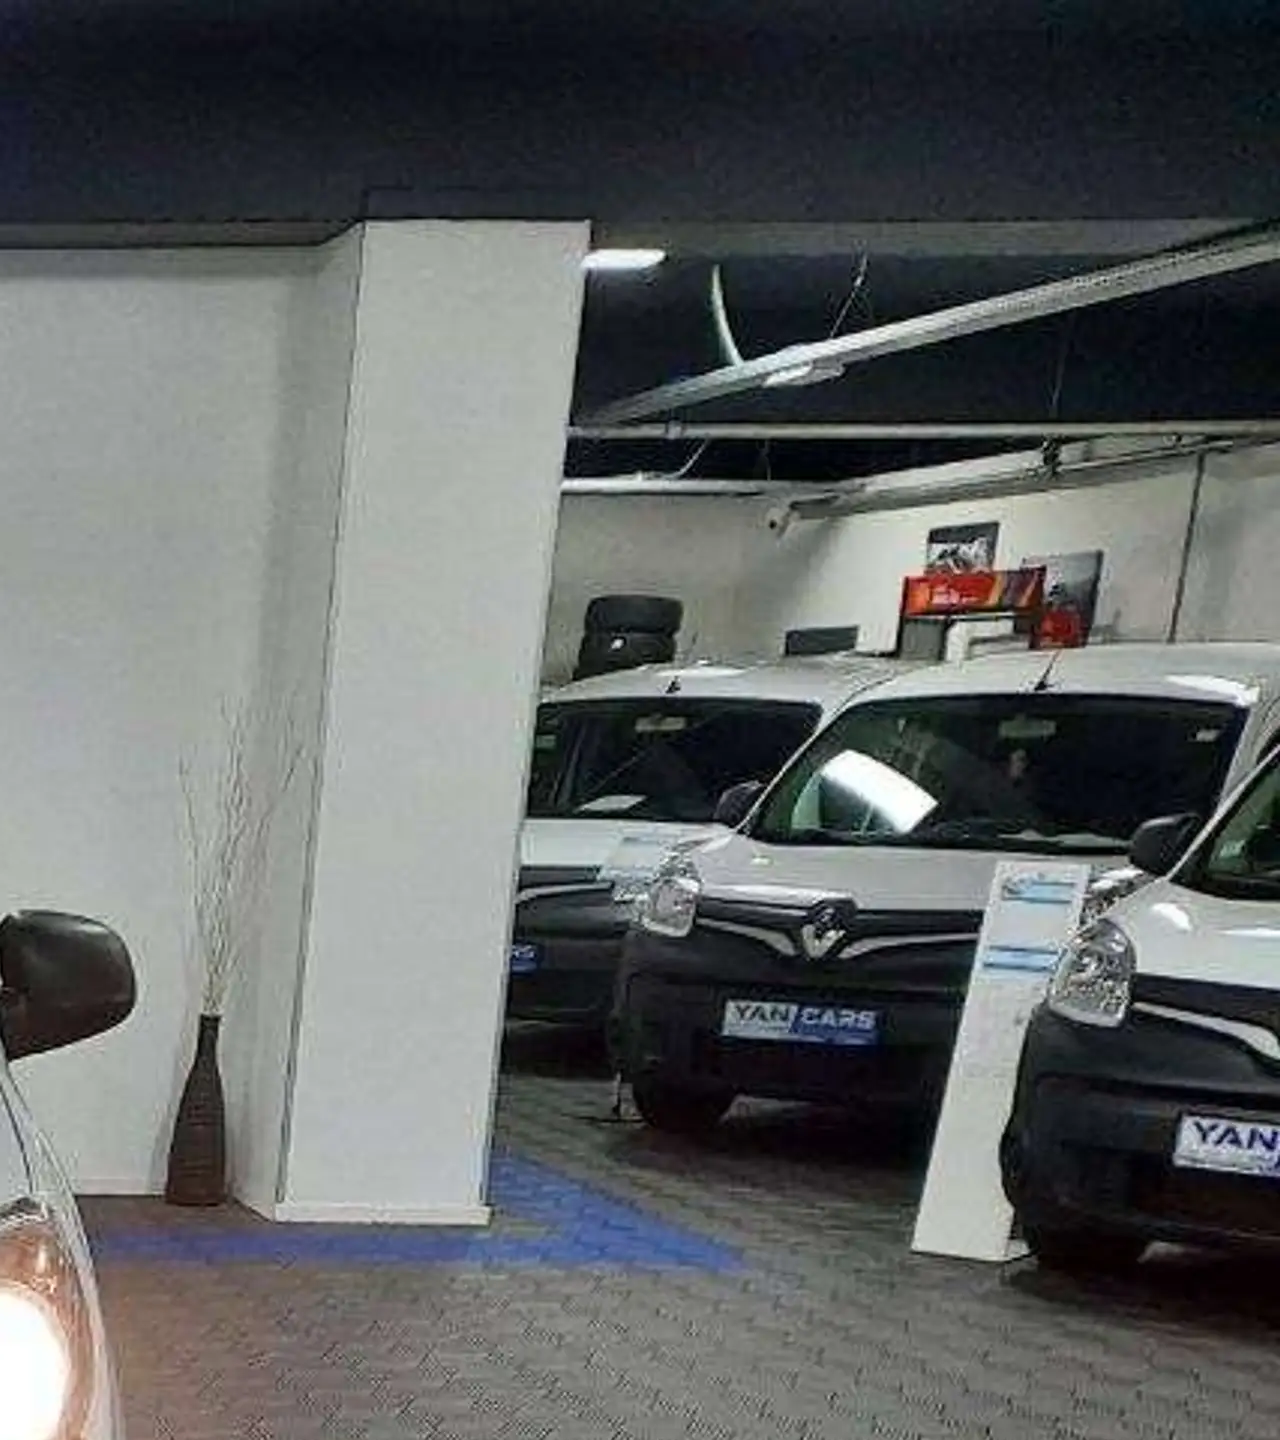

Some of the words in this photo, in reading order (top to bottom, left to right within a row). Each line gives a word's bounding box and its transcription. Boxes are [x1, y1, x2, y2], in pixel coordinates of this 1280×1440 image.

[736, 1004, 790, 1023] YAN
[801, 1006, 877, 1030] CARS
[1193, 1121, 1279, 1152] YAN
